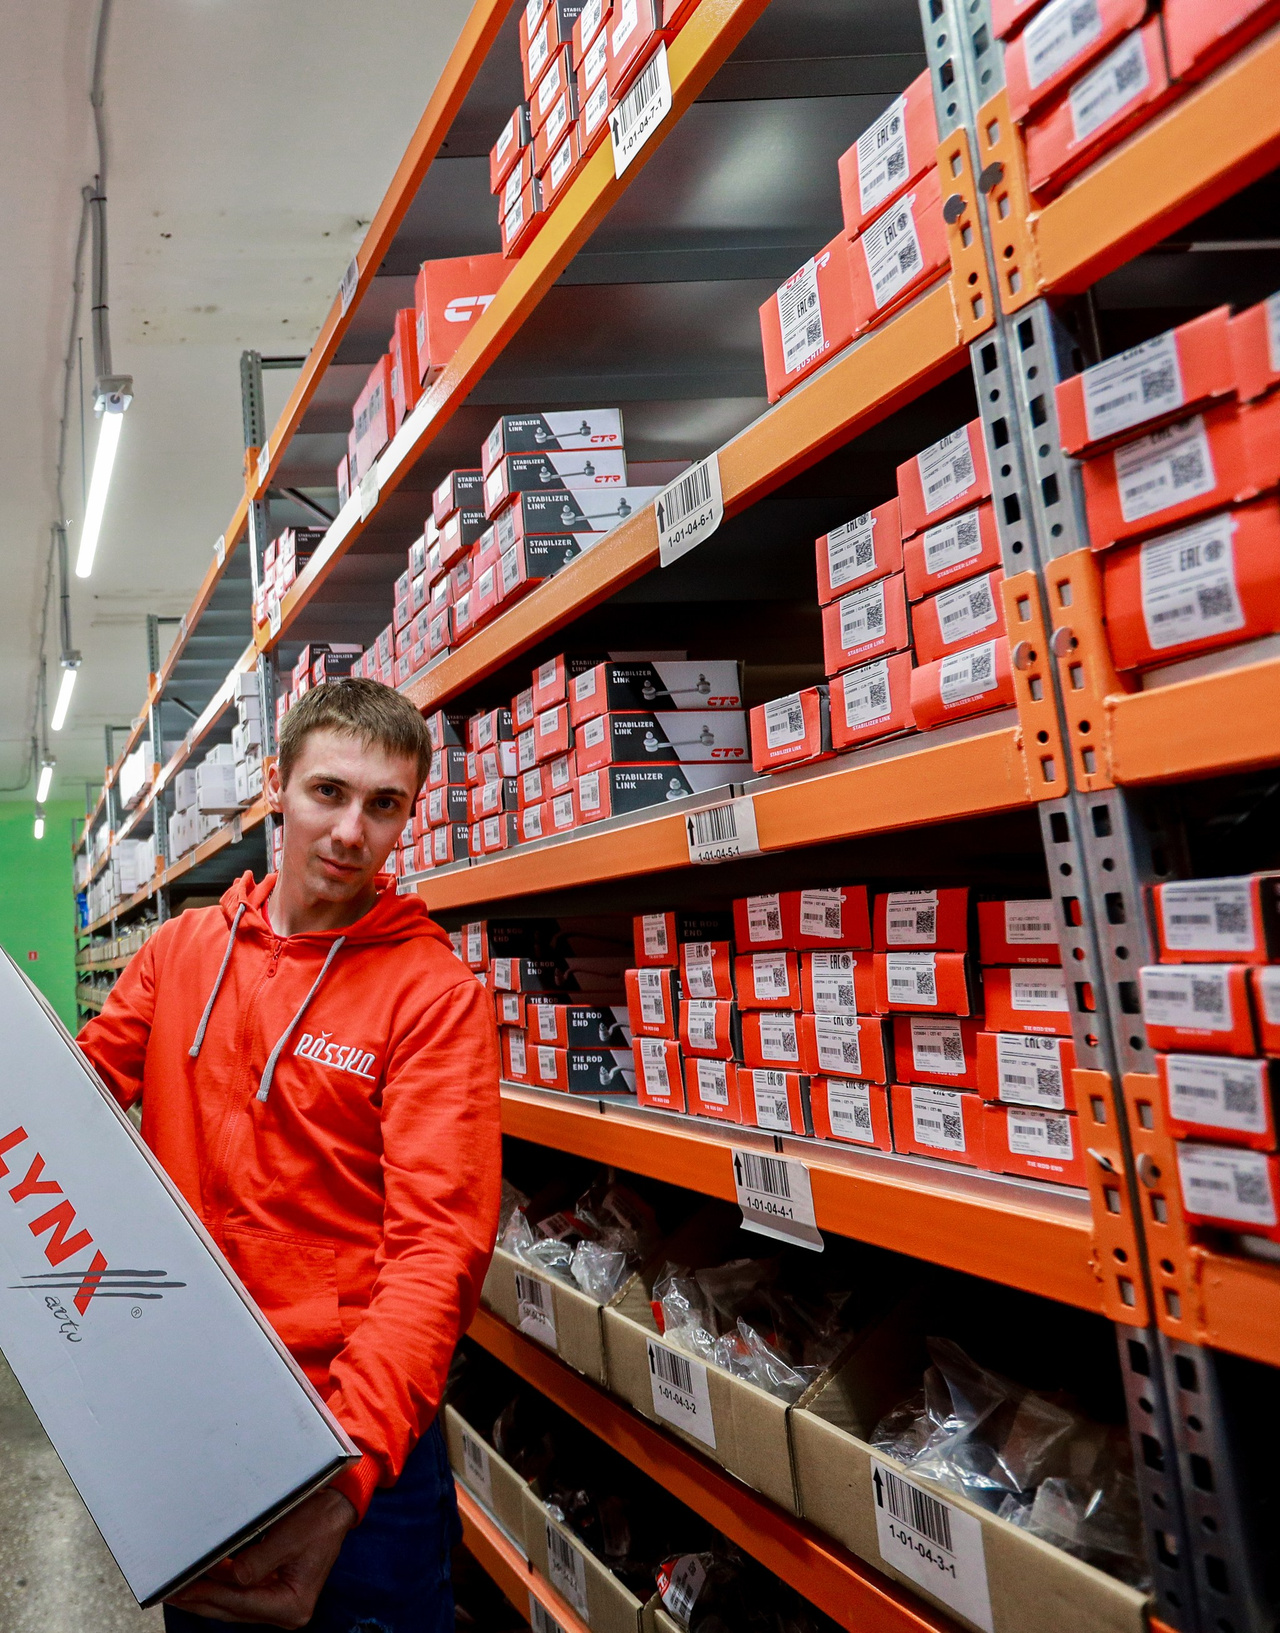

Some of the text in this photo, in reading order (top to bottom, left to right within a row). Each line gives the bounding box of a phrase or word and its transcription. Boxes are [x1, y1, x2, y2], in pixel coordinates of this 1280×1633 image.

[622, 96, 664, 156] 1-01-04-7-1
[796, 339, 830, 372] BUSHING
[508, 419, 541, 427] STABILIZER
[590, 434, 617, 444] CTR
[594, 474, 621, 483] CTR
[527, 494, 570, 503] STABILIZER
[668, 508, 714, 548] 1-01-04-6-1
[529, 538, 572, 547] STABILIZER
[848, 638, 885, 657] STABILIZER LINK
[707, 696, 739, 706] CTR
[944, 694, 984, 710] STABILIZER LINK
[852, 715, 891, 731] STABILIZER LINK
[710, 748, 744, 758] CTR
[769, 747, 792, 757] STABILIZER
[615, 773, 663, 781] STABILIZER
[698, 846, 740, 862] 1-01-04-5-1
[747, 1196, 794, 1220] 1-01-04-4-1
[659, 1385, 696, 1415] 1-01-04-3-2
[889, 1524, 956, 1579] 1-01-04-3-1
